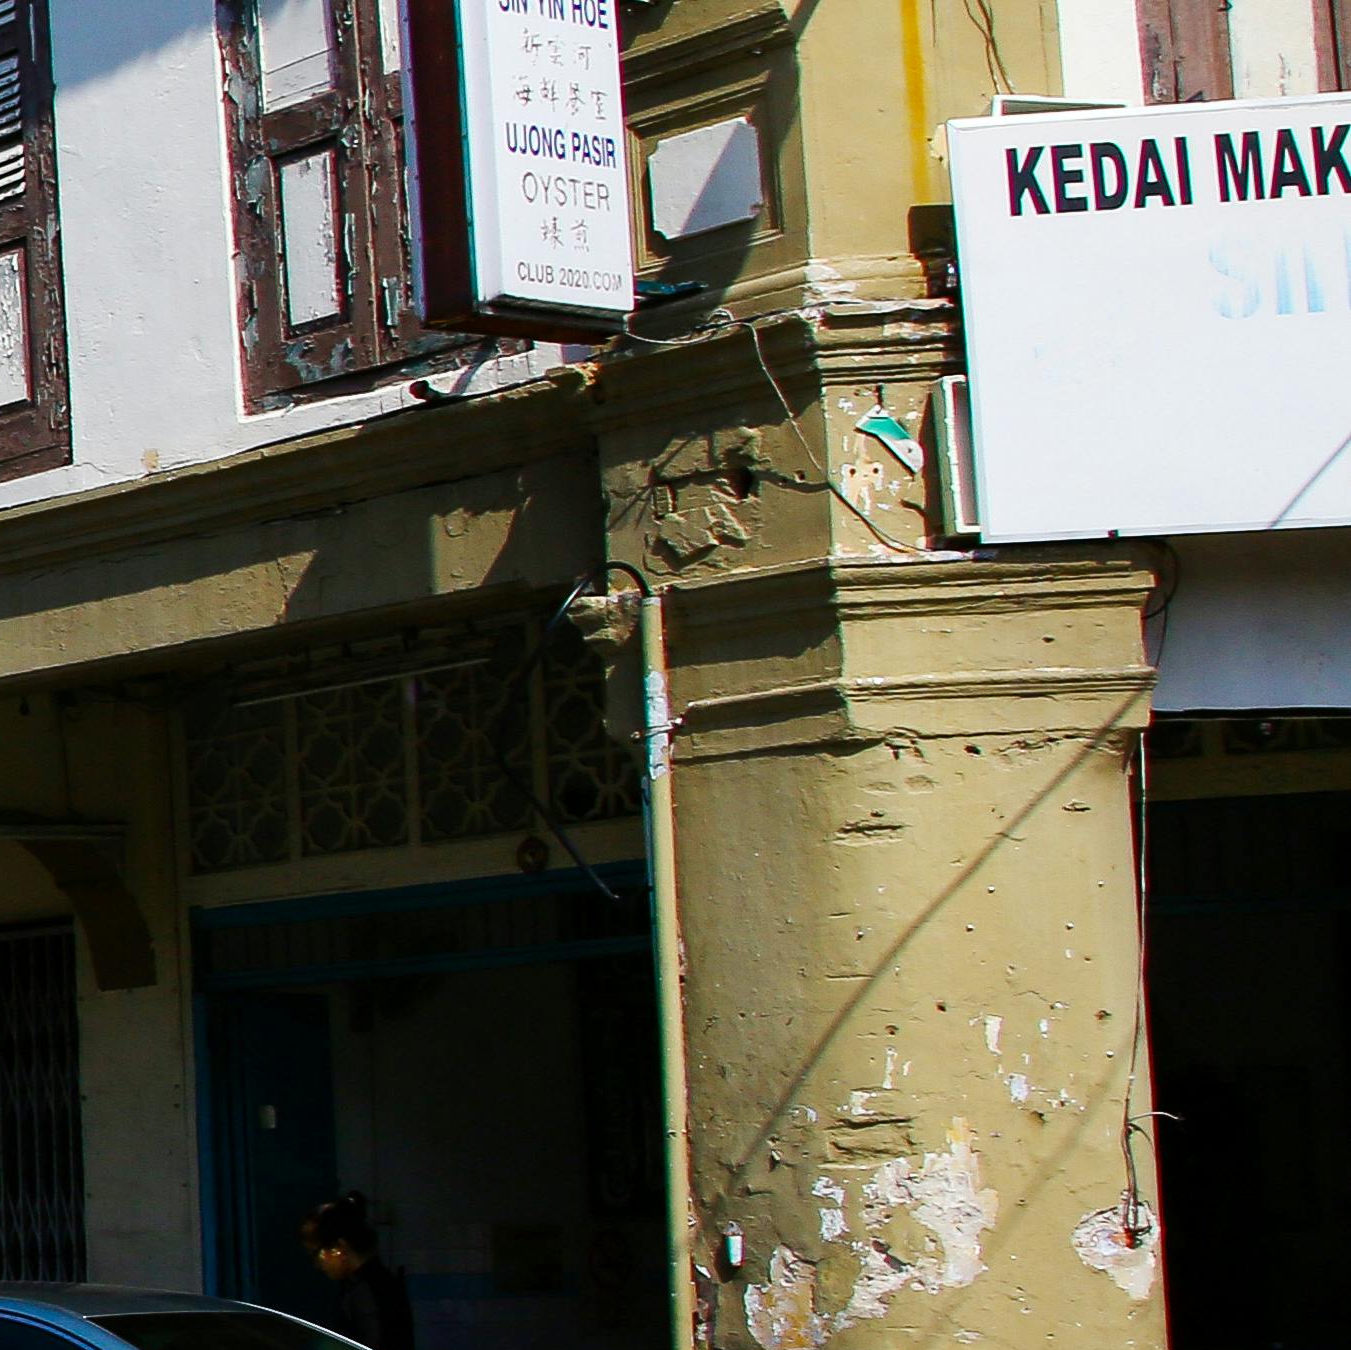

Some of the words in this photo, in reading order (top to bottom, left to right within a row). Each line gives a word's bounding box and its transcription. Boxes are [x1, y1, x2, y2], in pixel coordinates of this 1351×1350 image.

[572, 0, 608, 29] HOE
[505, 122, 566, 160] UJONG
[571, 132, 617, 169] PASIR
[1004, 135, 1194, 217] KEDAI
[1213, 123, 1351, 203] MAK
[522, 171, 610, 211] OYSTER
[517, 261, 554, 284] CLUB
[559, 267, 622, 292] 2020.COM
